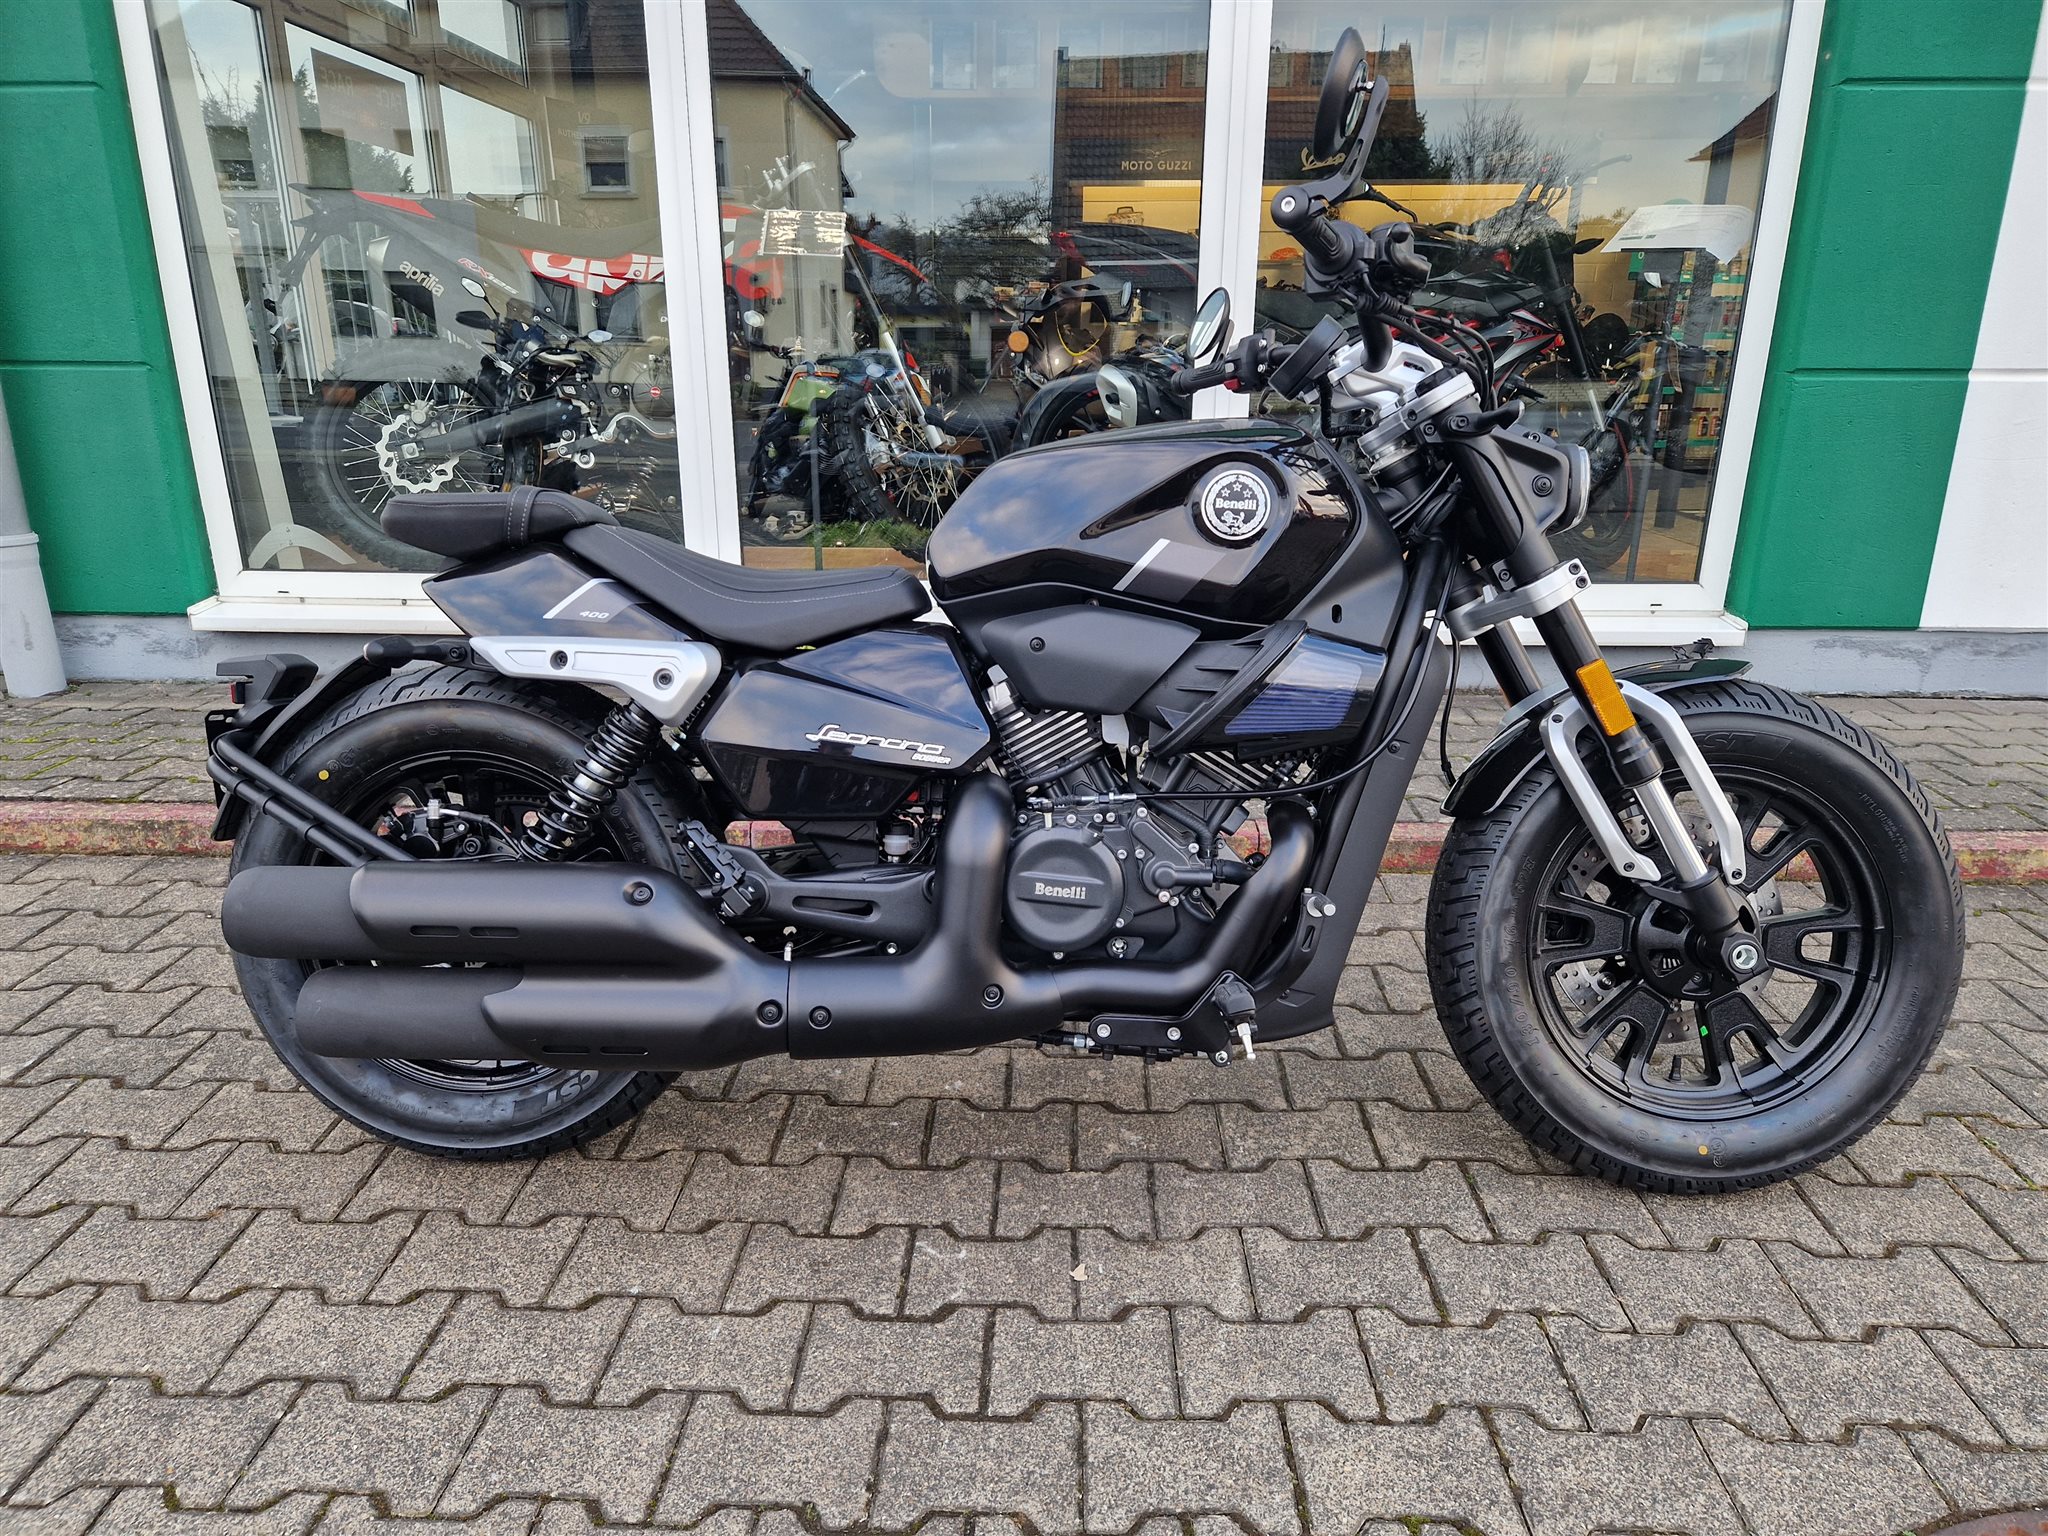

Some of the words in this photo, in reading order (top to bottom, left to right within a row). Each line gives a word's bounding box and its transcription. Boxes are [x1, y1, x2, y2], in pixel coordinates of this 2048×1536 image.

[1121, 160, 1153, 171] MOTO
[1157, 160, 1192, 171] GUZZI
[399, 260, 445, 297] aprilia
[1215, 497, 1257, 511] Benelli
[579, 611, 610, 619] 400
[805, 724, 946, 756] Leoncino
[911, 752, 951, 765] BOBBER
[1034, 882, 1087, 900] Benelli
